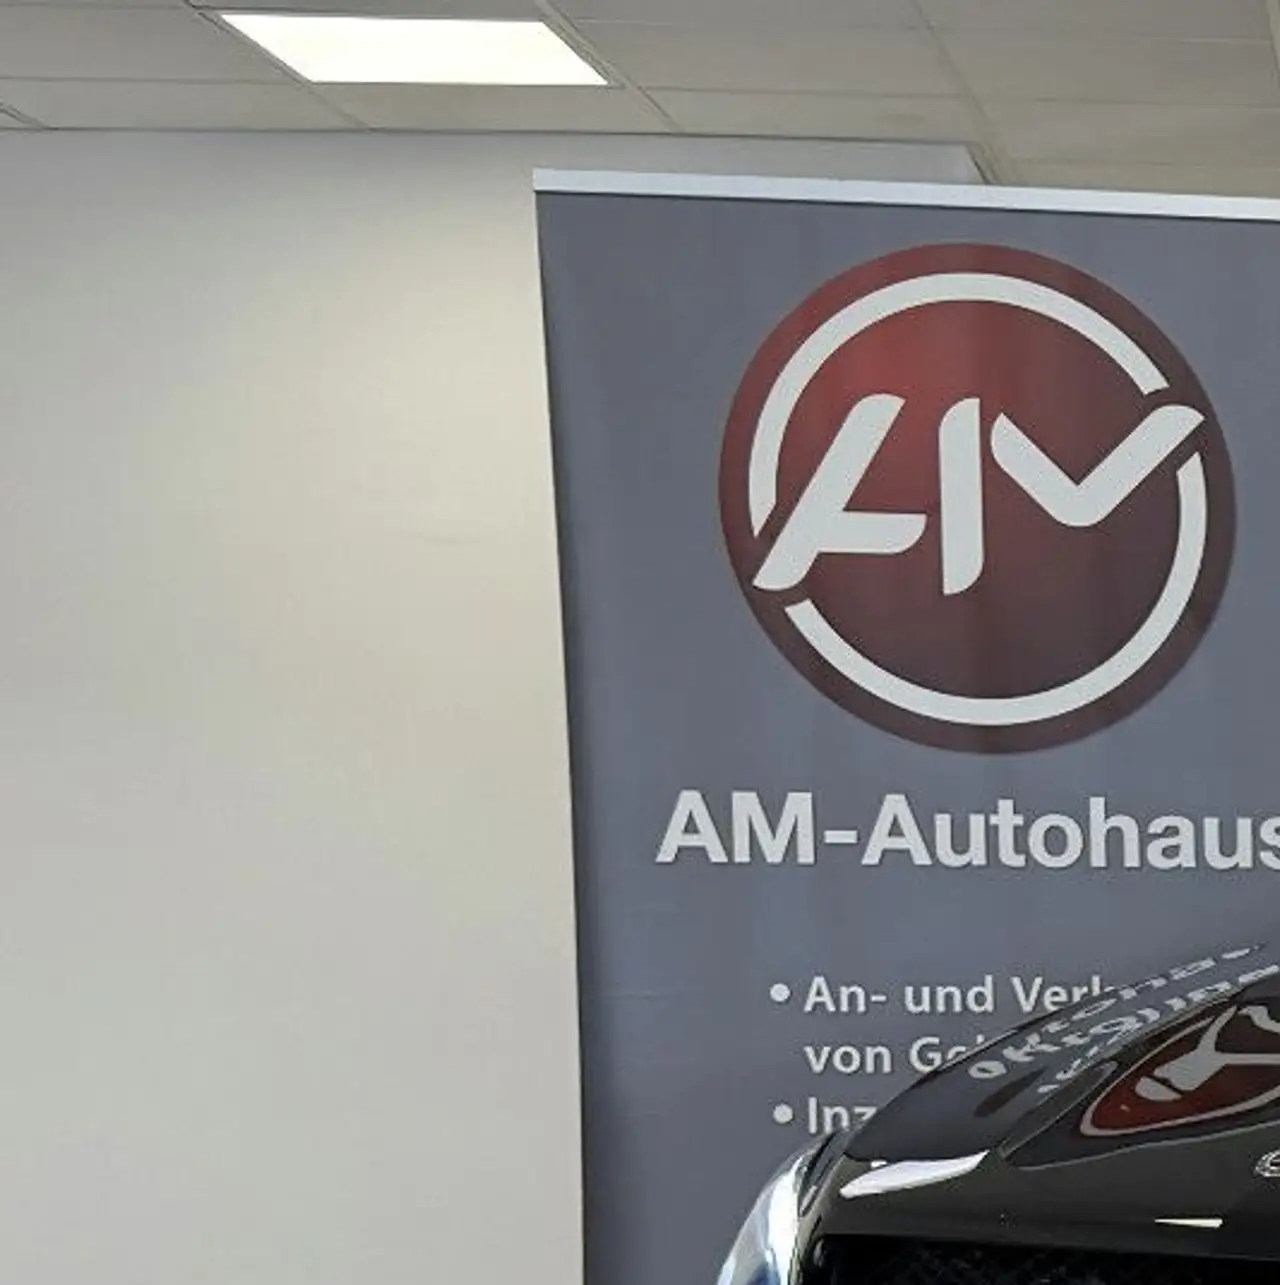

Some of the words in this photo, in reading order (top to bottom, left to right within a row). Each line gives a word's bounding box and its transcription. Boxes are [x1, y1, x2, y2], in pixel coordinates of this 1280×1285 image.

[803, 975, 888, 1014] An-
[904, 974, 994, 1014] und
[804, 1044, 893, 1074] von
